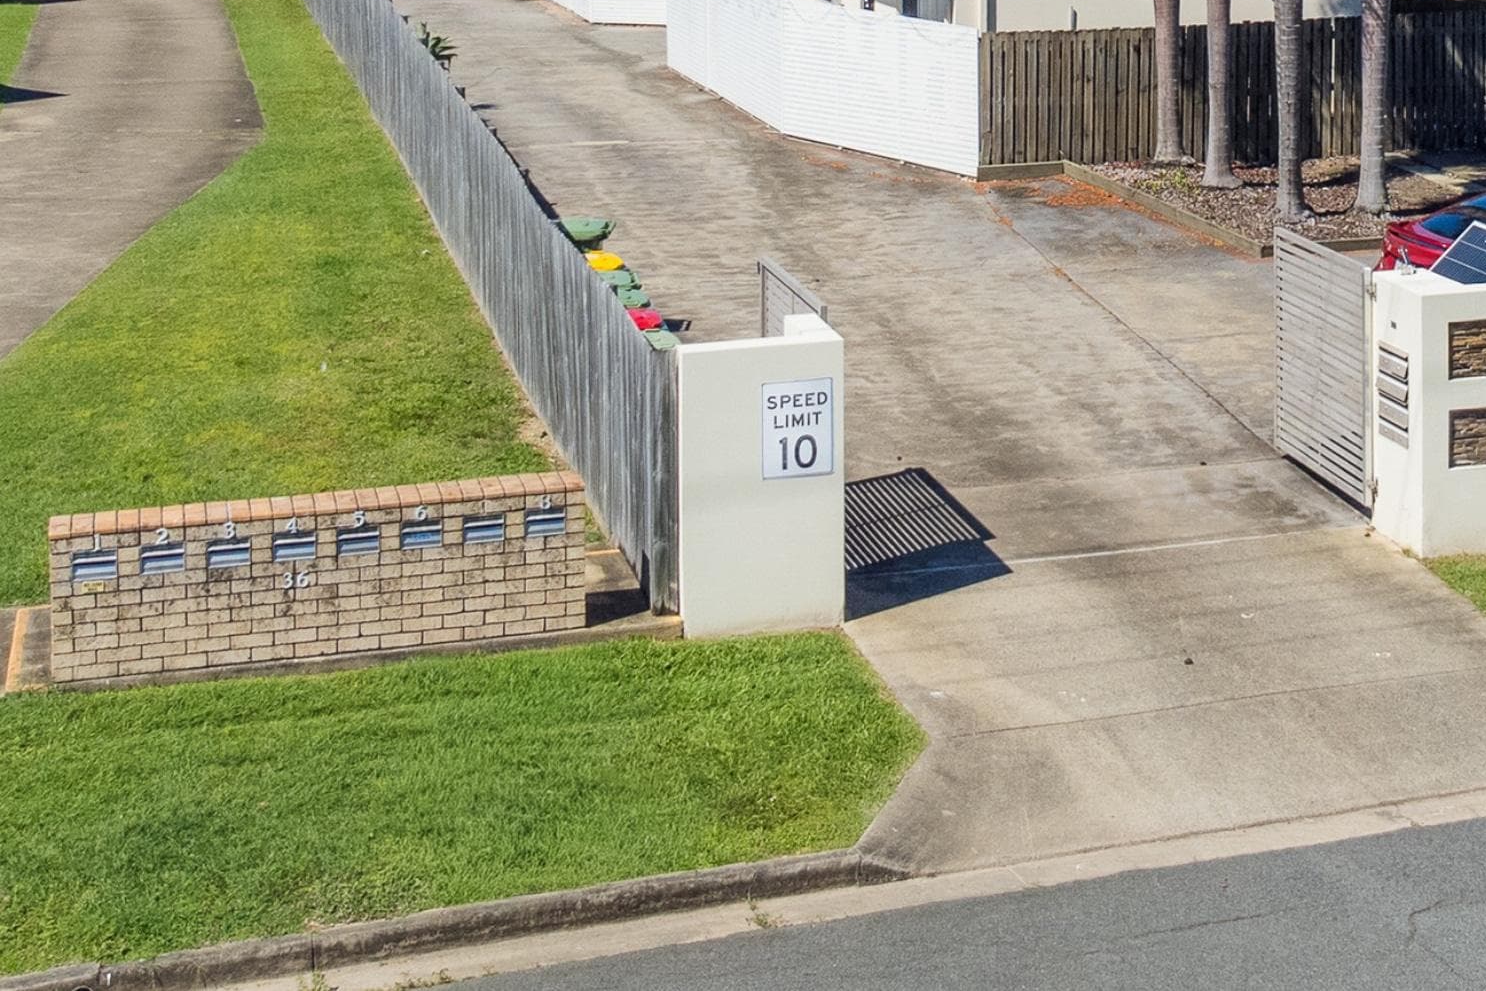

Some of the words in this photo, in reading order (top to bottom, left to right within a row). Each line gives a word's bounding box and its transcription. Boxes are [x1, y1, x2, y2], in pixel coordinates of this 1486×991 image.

[767, 391, 828, 410] SPEED
[773, 411, 822, 429] LIMIT
[779, 434, 818, 470] 10
[353, 510, 366, 528] 5
[415, 505, 428, 522] 6
[223, 520, 236, 539] 3
[286, 516, 299, 534] 4
[155, 528, 169, 545] 2
[282, 570, 310, 589] 36
